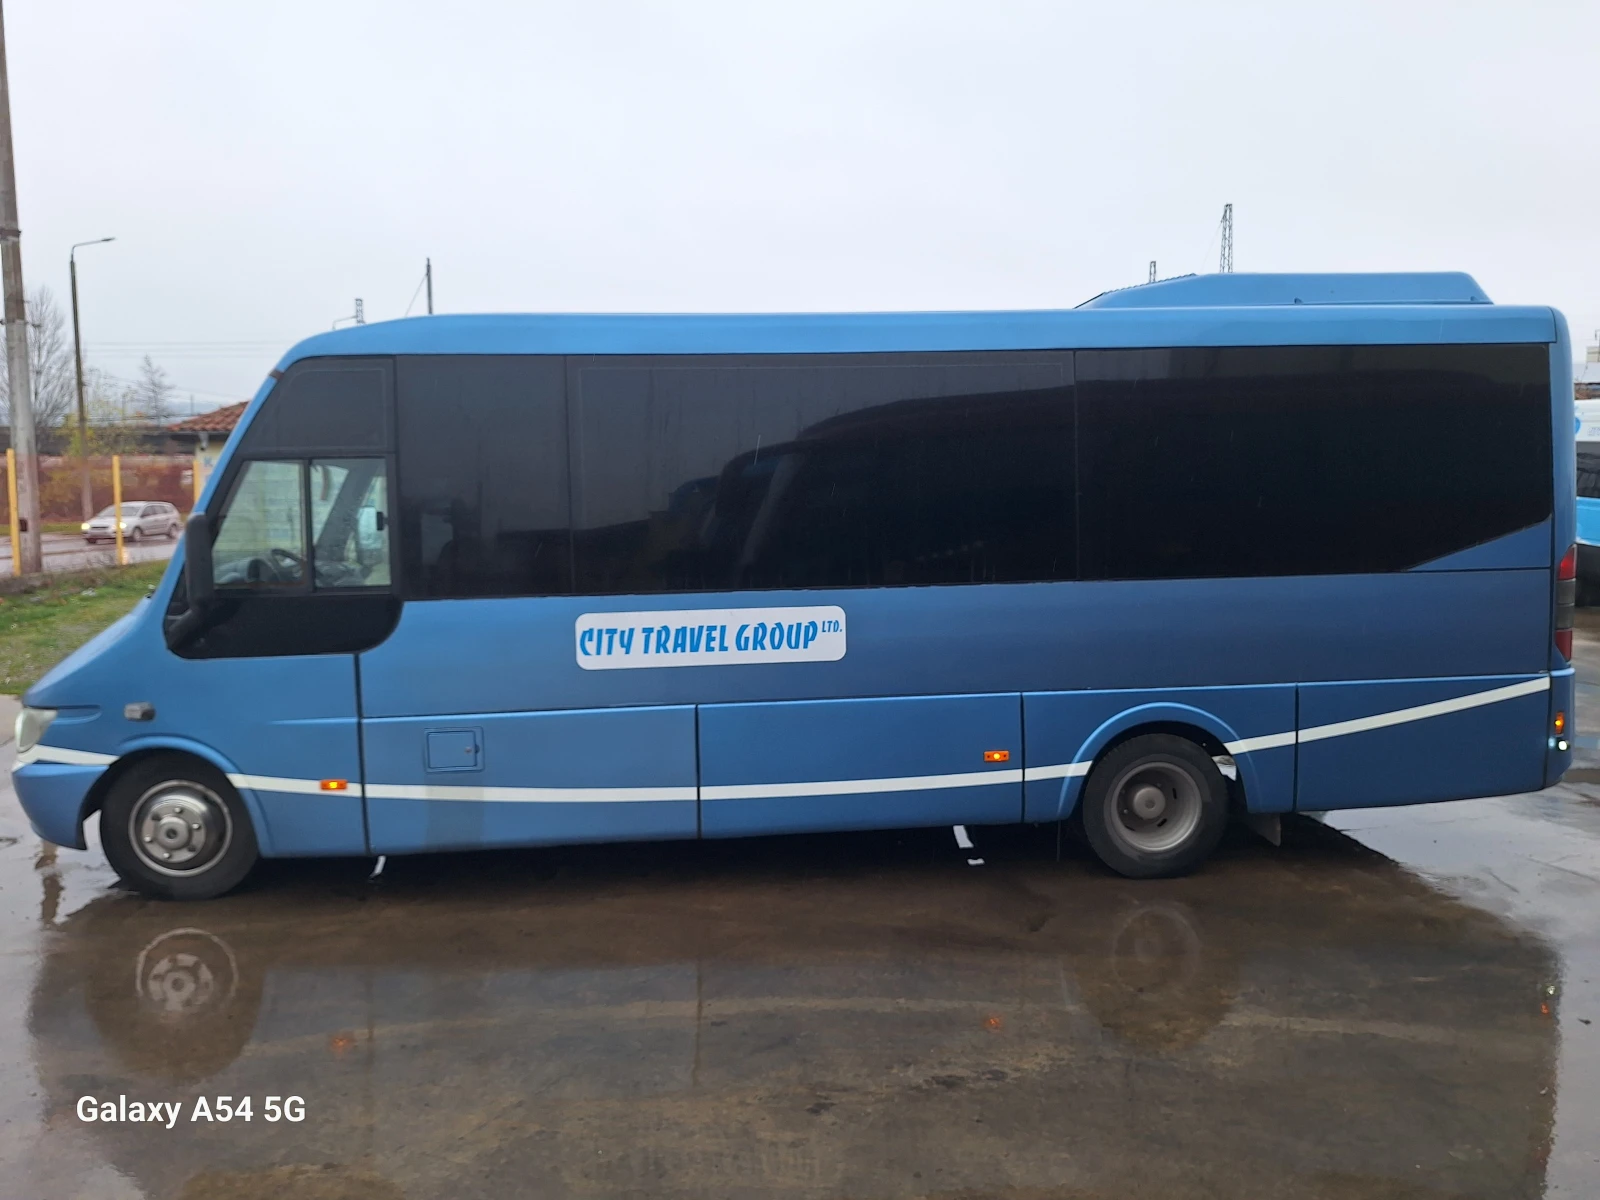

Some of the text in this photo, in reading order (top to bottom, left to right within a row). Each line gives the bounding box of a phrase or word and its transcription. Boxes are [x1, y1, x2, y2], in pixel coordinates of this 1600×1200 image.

[579, 619, 843, 656] CITY TRAVEL GROUP LTD.
